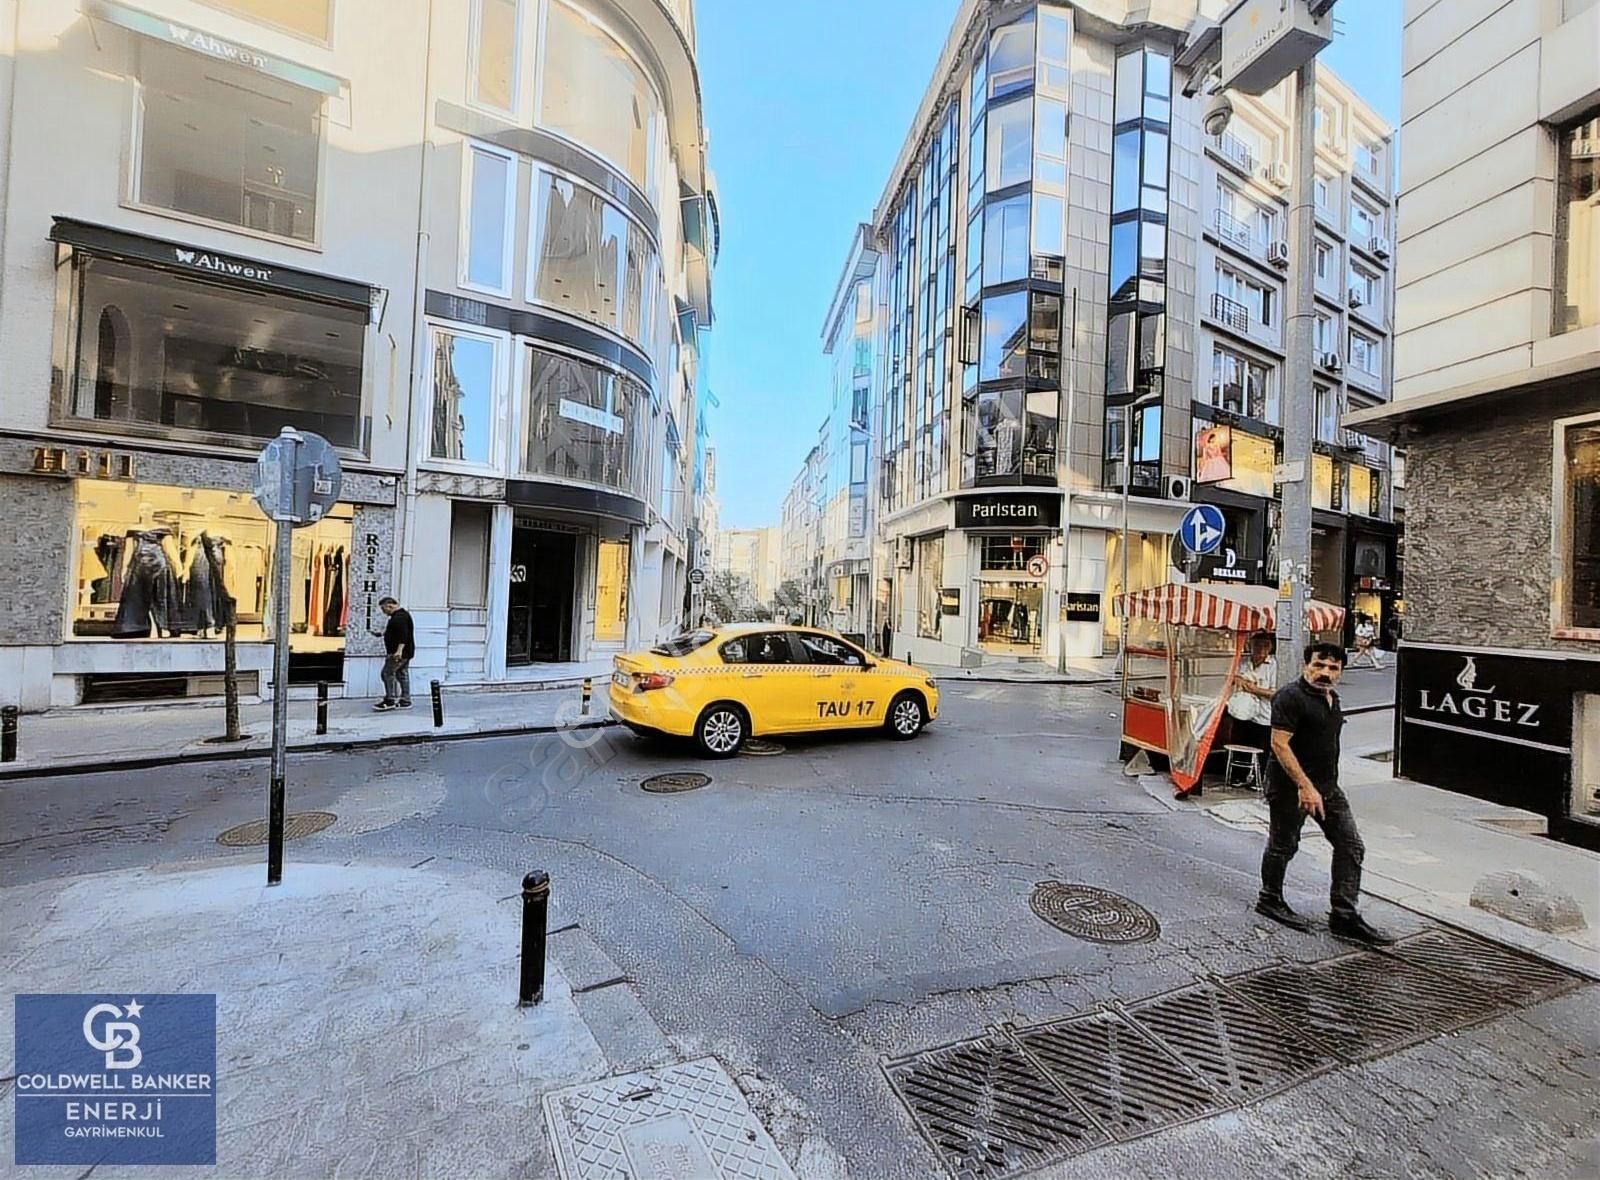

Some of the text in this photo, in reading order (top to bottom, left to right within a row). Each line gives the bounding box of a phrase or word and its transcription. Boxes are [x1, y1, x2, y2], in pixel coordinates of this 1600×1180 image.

[191, 33, 265, 68] Ahwen
[195, 254, 270, 281] Ahwen
[972, 503, 1038, 518] Paristan
[365, 533, 379, 574] Ross
[1067, 601, 1099, 612] aristan
[817, 700, 875, 718] TAU 17
[1418, 690, 1541, 727] LAGEZ
